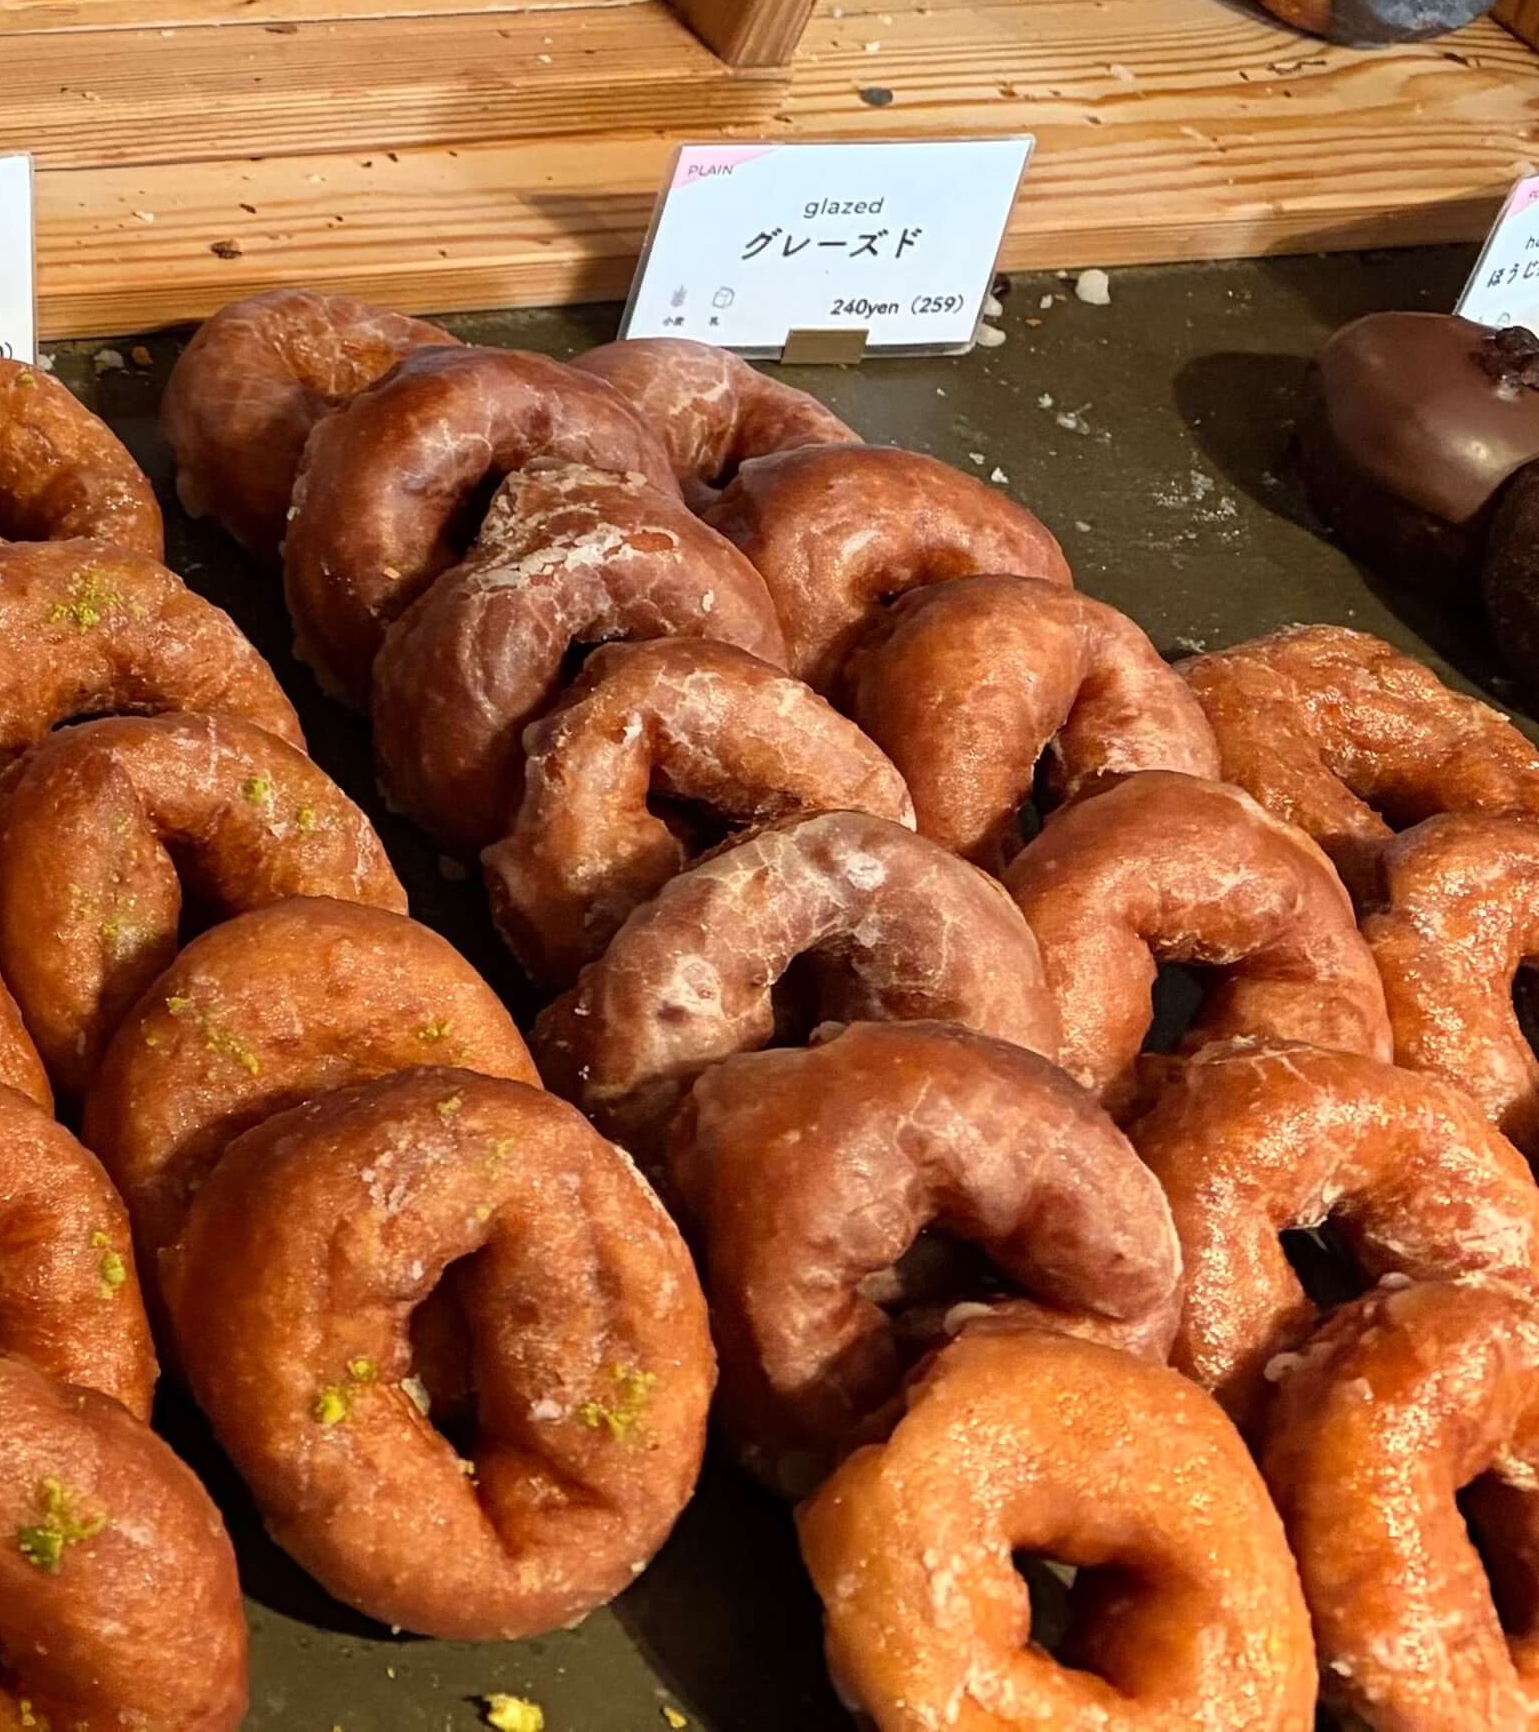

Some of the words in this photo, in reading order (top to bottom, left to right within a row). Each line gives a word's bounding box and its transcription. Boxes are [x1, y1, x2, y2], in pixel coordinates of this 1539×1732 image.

[687, 164, 735, 177] PLAIN
[803, 197, 885, 219] glazed
[740, 227, 923, 260] グレーズド
[830, 298, 899, 319] 240yen
[910, 295, 966, 316] (259)
